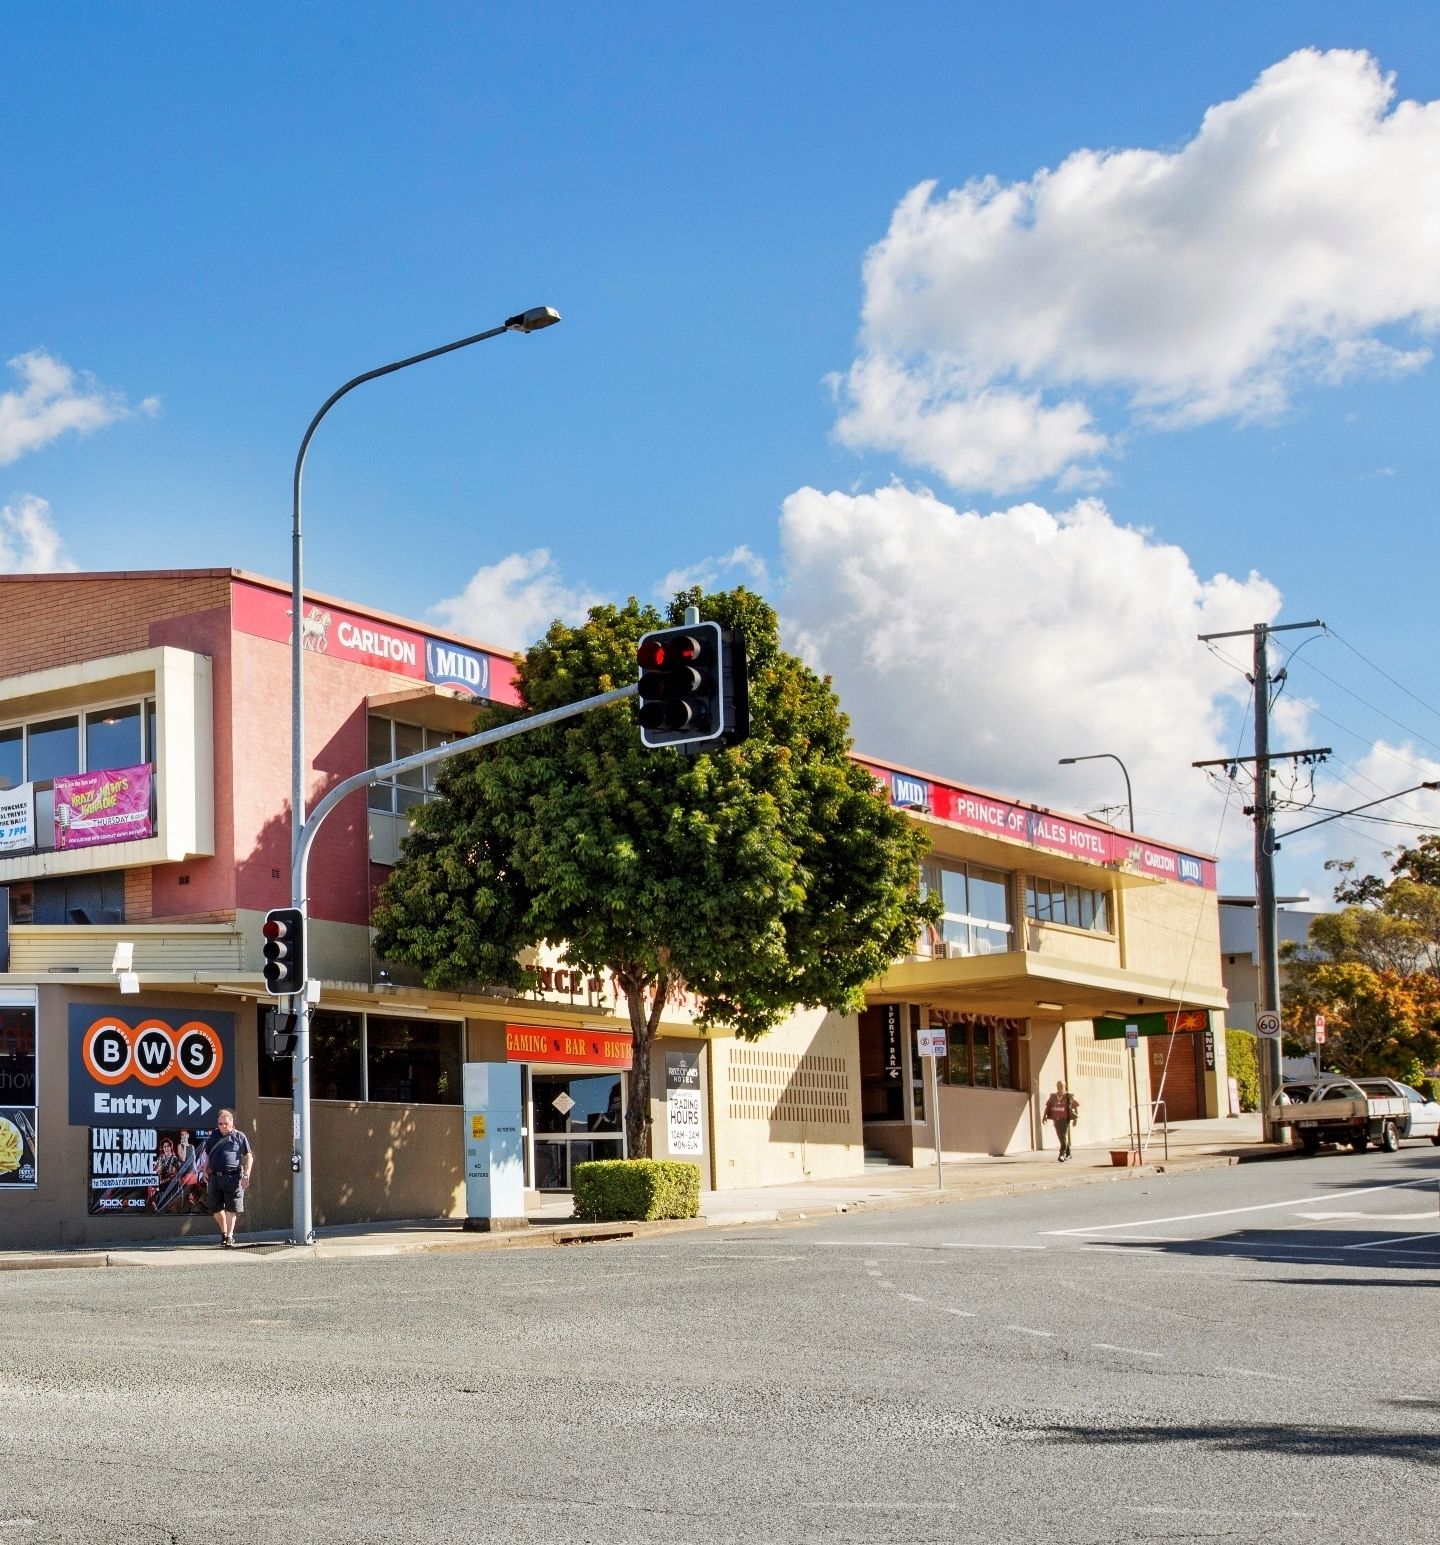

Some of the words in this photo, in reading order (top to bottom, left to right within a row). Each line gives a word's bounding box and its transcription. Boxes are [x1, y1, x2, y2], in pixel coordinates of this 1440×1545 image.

[337, 621, 417, 666] CARLTON
[435, 647, 481, 684] MID
[896, 779, 923, 805] MID
[0, 803, 28, 812] PUNCHES
[93, 815, 129, 826] THURSDAY
[957, 797, 1005, 827] PRINCE
[1007, 812, 1024, 832] OF
[1027, 814, 1067, 844] WALES
[1069, 830, 1106, 854] HOTEL
[8, 826, 28, 838] 7PM
[1144, 850, 1174, 873] CARLTON
[1181, 857, 1199, 880] MID
[1165, 1010, 1207, 1033] TAB
[1260, 1018, 1277, 1030] 60
[116, 1028, 130, 1045] BEER
[199, 1030, 216, 1052] SPIRITS
[506, 1033, 548, 1053] GAMING
[565, 1037, 586, 1056] BAR
[604, 1041, 633, 1059] BISTR
[160, 1059, 173, 1077] WINE
[94, 1092, 161, 1120] Entry
[669, 1097, 698, 1109] TRADING
[670, 1110, 698, 1124] HOURS
[92, 1127, 120, 1150] LIVE
[122, 1127, 157, 1150] BAND
[688, 1130, 699, 1139] 2AM
[673, 1140, 697, 1149] MON-SUN
[92, 1152, 158, 1174] KARAOKE
[99, 1179, 122, 1187] THURSDAY
[122, 1178, 128, 1186] OF
[128, 1178, 142, 1186] EVERY
[142, 1177, 158, 1185] MONTH
